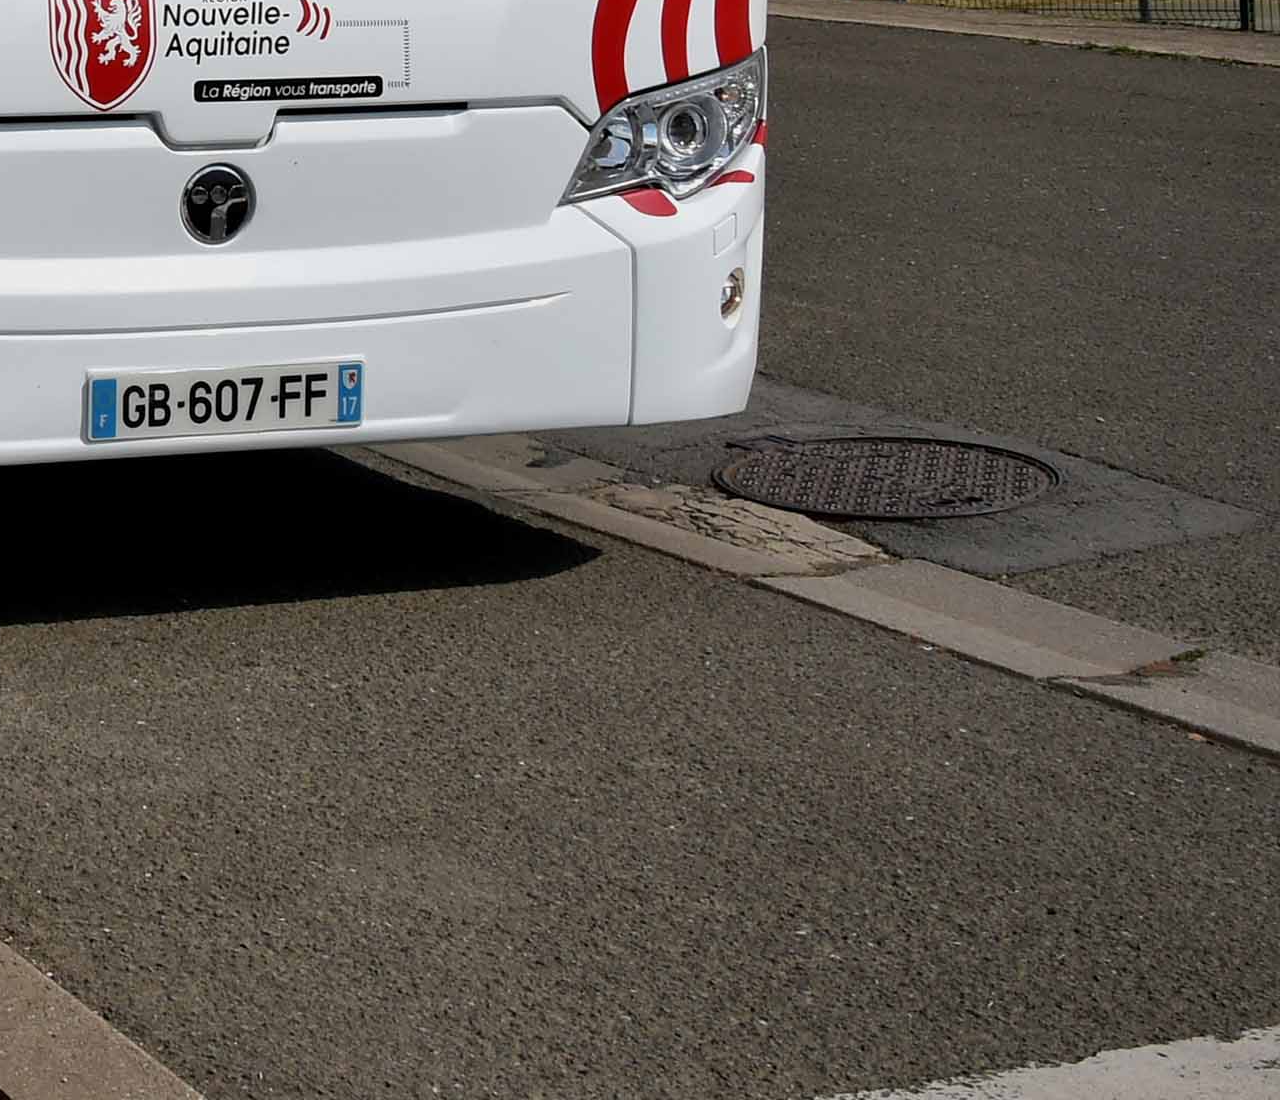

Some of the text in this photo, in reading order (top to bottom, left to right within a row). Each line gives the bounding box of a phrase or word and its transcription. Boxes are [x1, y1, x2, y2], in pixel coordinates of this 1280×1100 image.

[163, 1, 290, 27] Nouvelle-
[165, 30, 290, 65] Aquitaine
[201, 80, 377, 100] La Région vous transporte
[341, 396, 357, 417] 17
